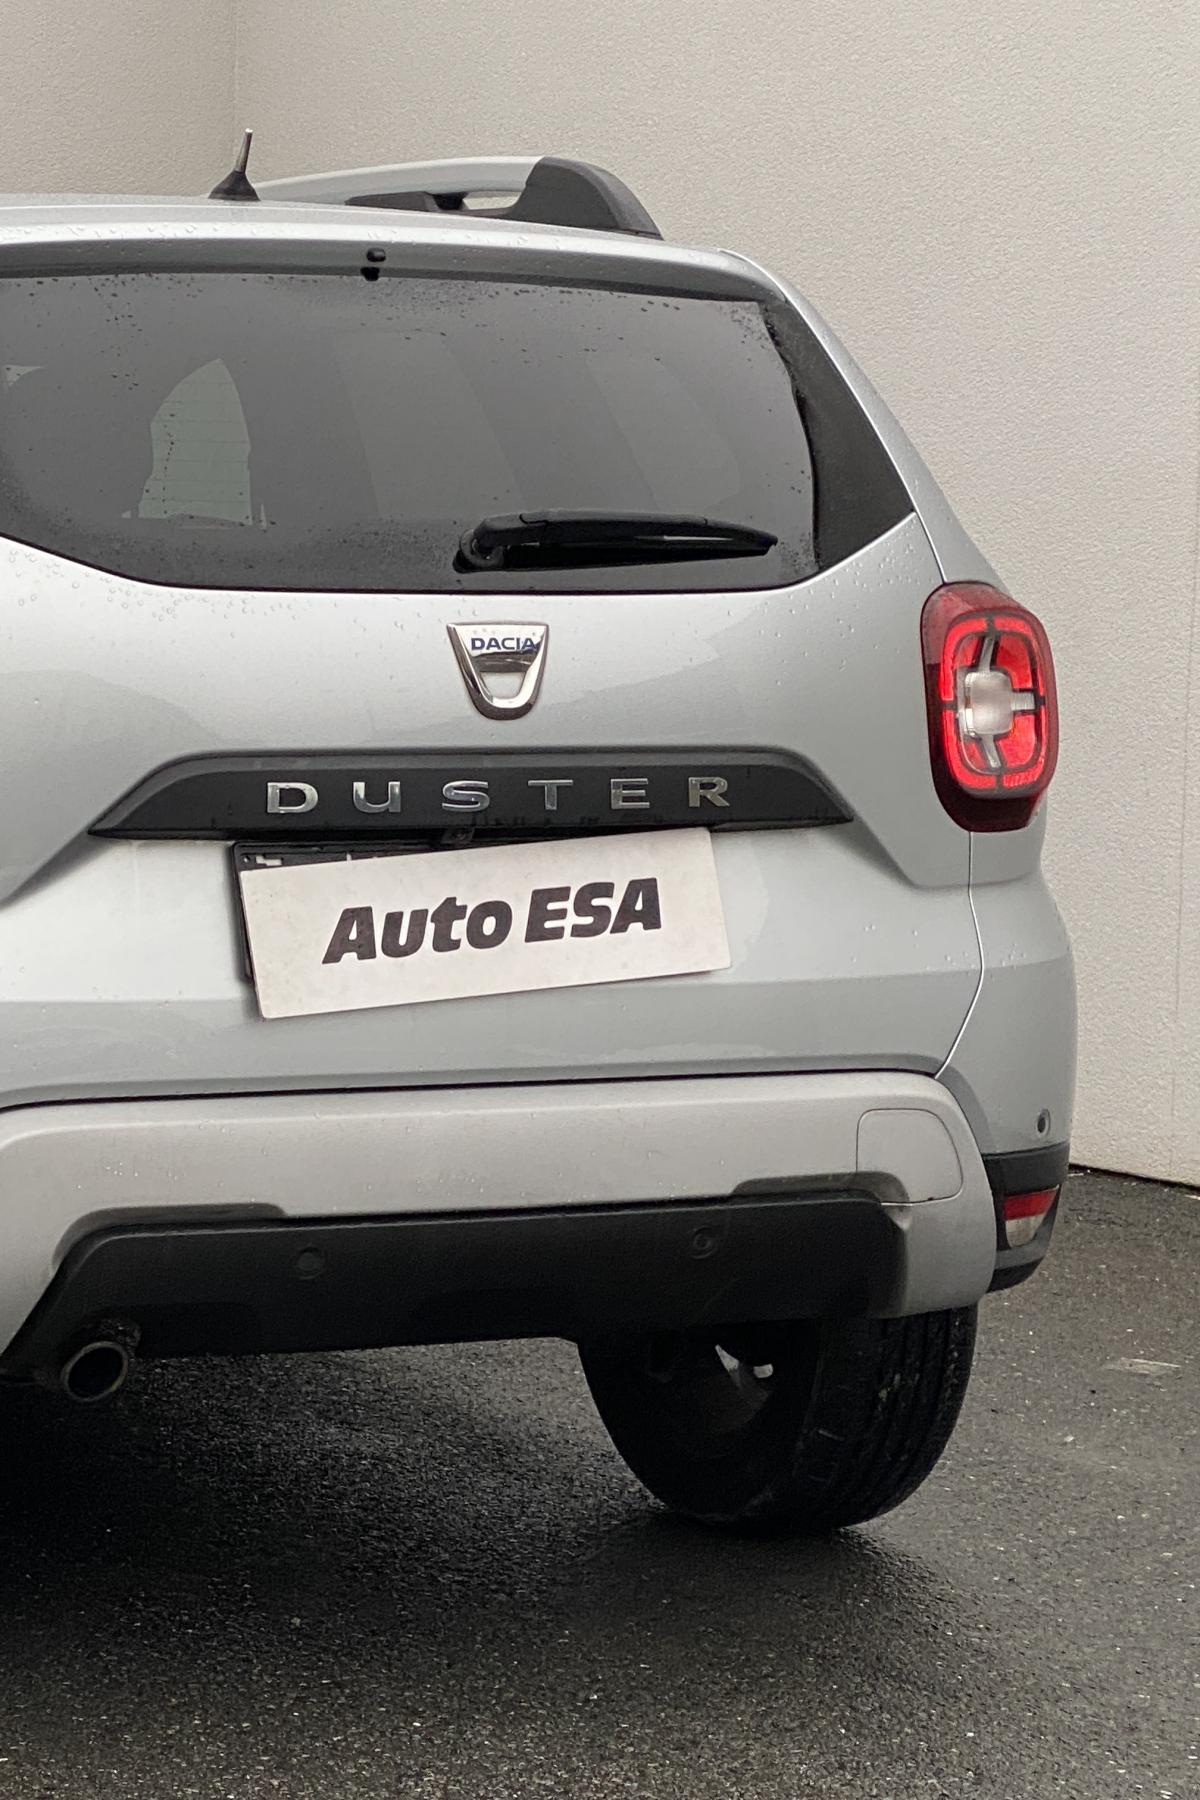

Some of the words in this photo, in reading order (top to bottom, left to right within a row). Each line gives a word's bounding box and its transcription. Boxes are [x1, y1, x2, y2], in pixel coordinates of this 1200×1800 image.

[471, 637, 537, 651] DACIA
[266, 776, 730, 814] DUSTER
[321, 897, 513, 964] Auto
[525, 877, 662, 943] ESA
